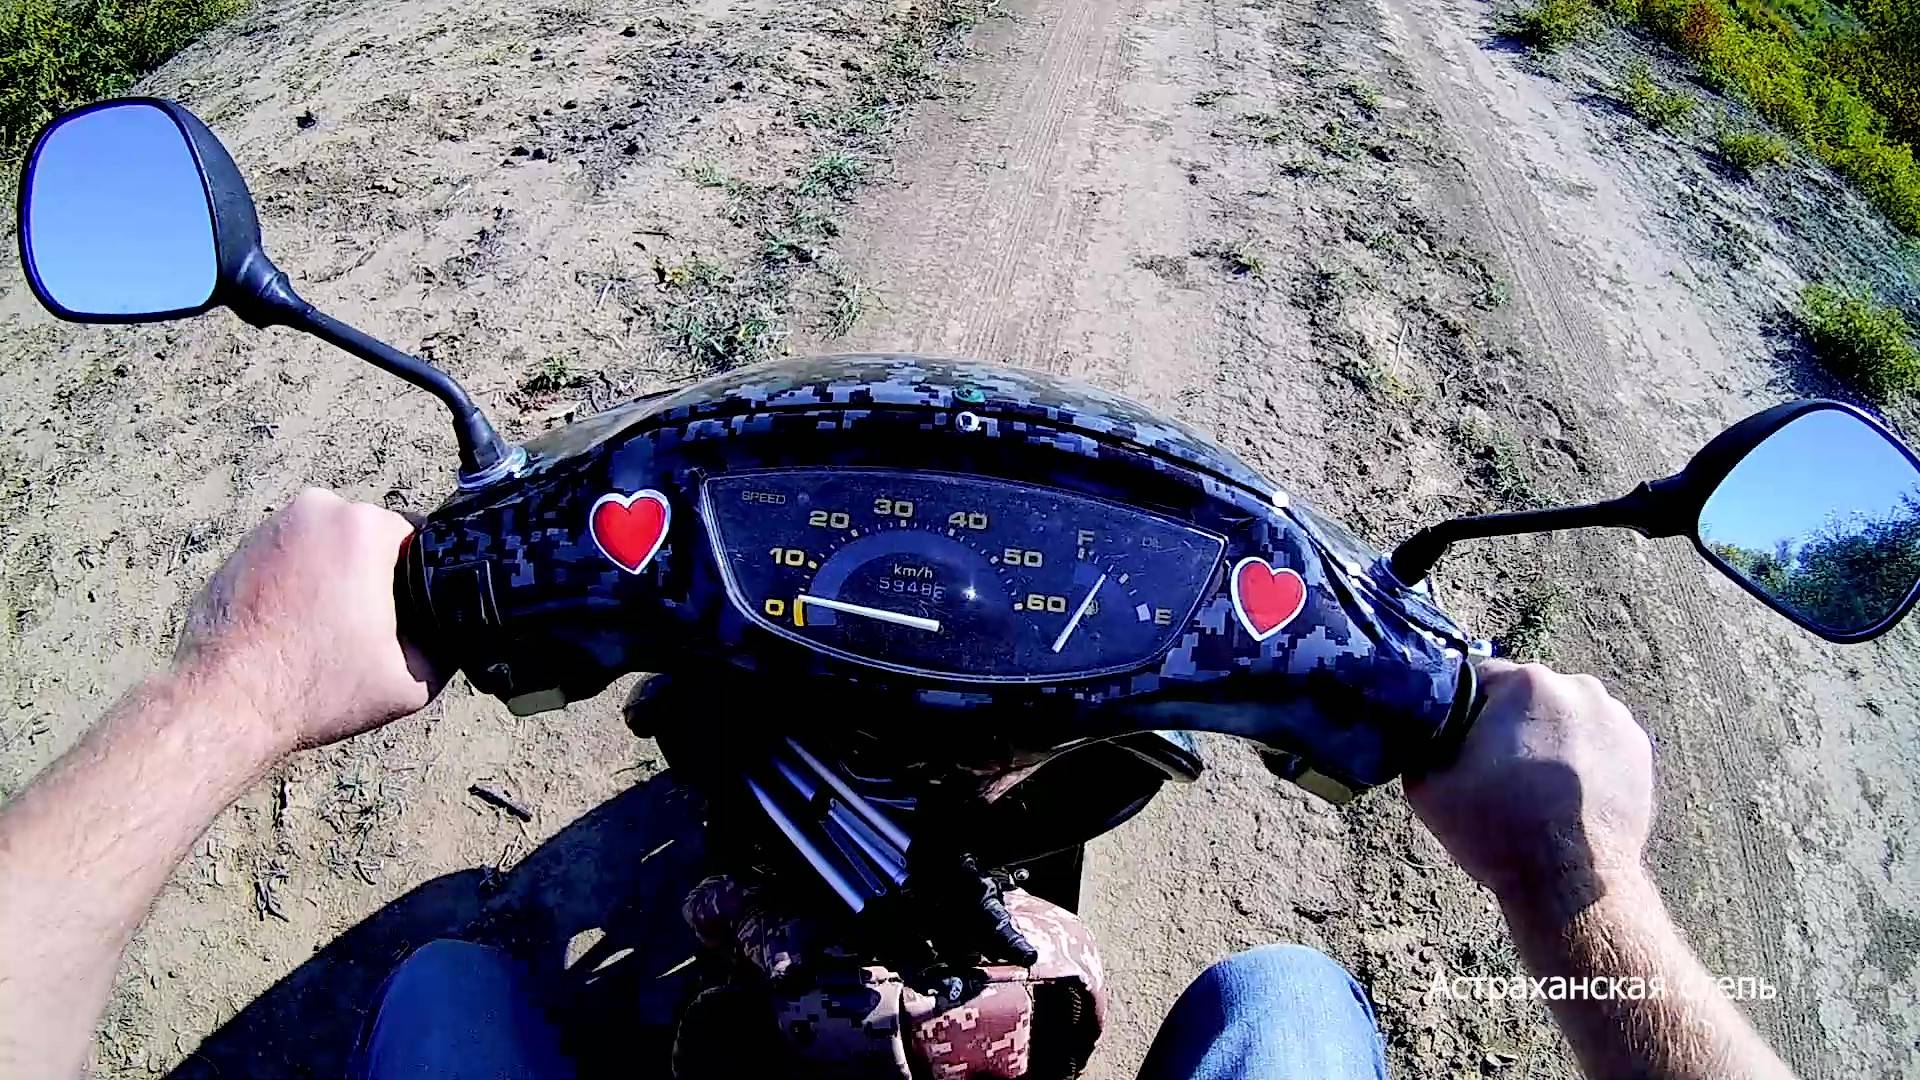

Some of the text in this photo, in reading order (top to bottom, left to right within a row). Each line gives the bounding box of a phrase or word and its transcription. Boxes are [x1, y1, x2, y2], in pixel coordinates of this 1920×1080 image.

[742, 491, 785, 504] SPEED
[873, 498, 914, 517] 30
[809, 510, 850, 529] 20
[948, 511, 987, 530] 40
[1078, 529, 1095, 546] F
[769, 547, 805, 566] 10
[1002, 548, 1043, 568] 50
[894, 563, 933, 579] km/h
[764, 598, 785, 616] 0
[1026, 594, 1066, 613] 60
[1154, 608, 1172, 625] E
